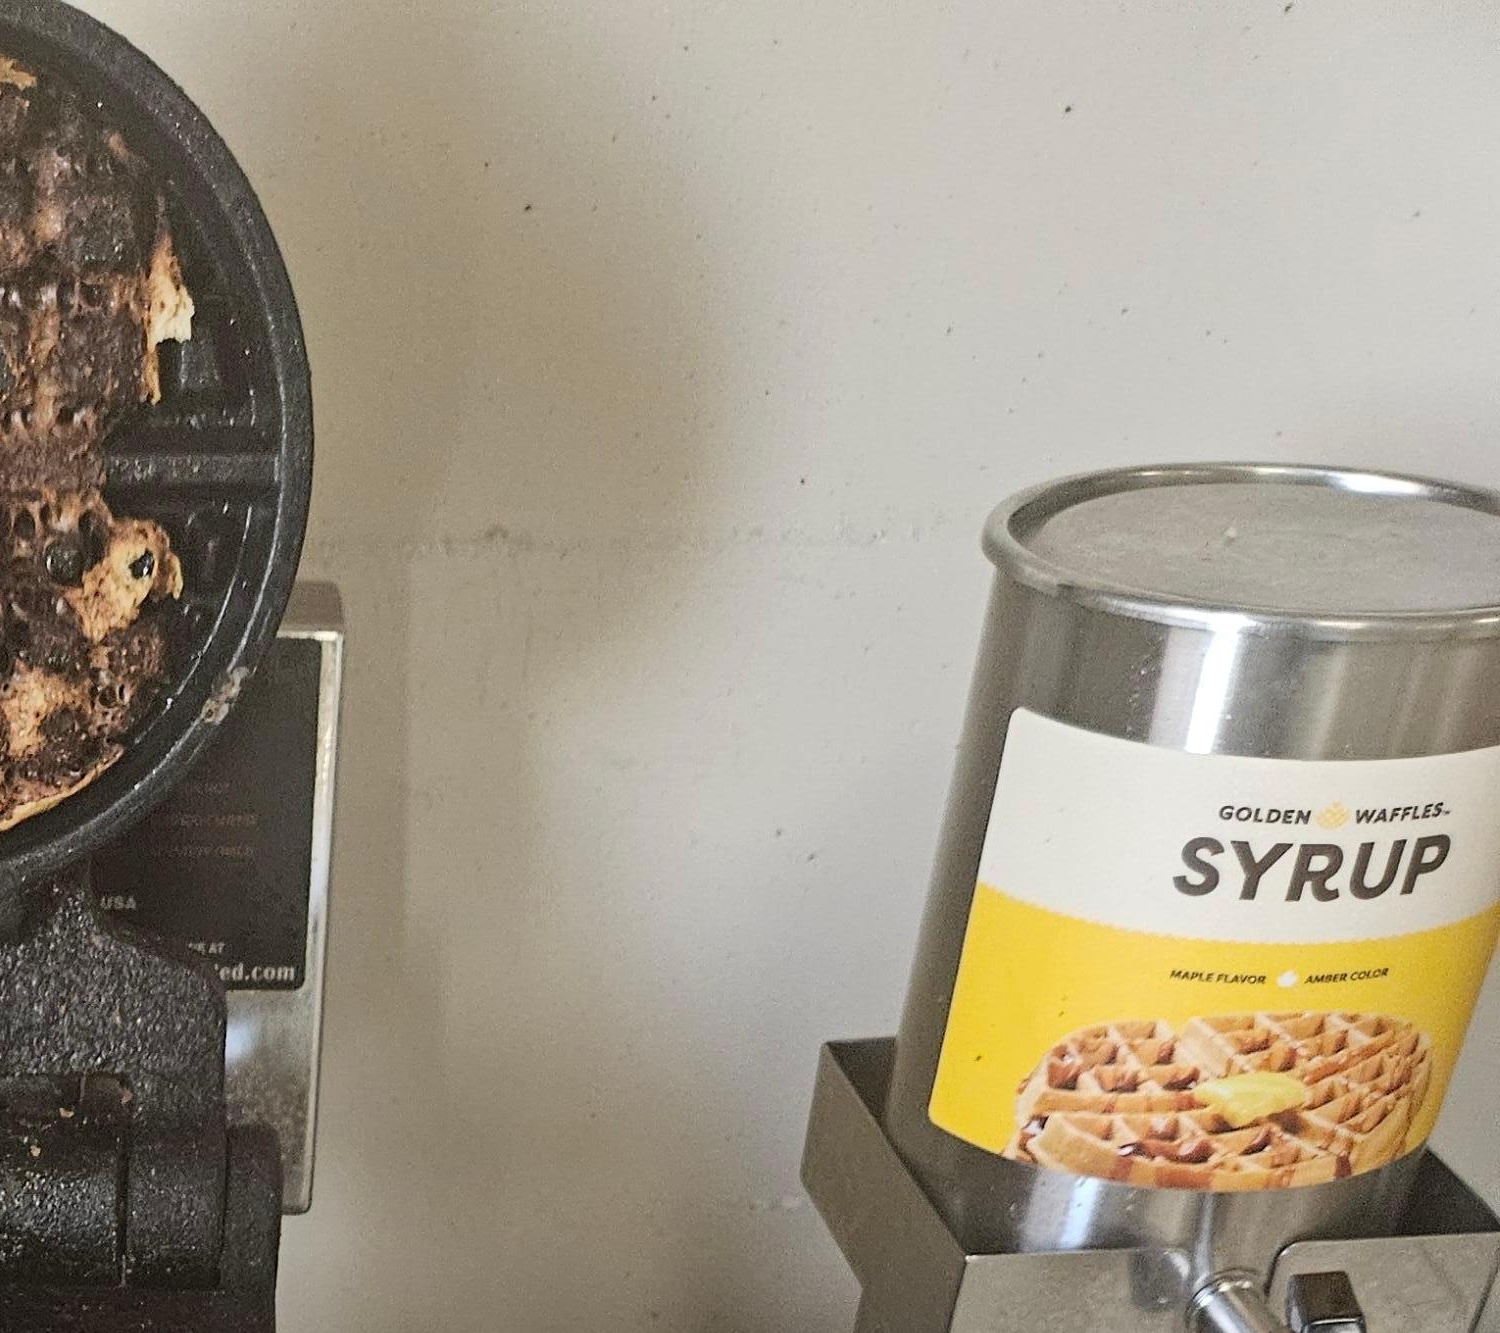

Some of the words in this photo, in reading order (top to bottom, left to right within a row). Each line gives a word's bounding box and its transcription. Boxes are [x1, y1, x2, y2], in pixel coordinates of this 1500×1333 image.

[1218, 805, 1312, 825] GOLDEN
[1172, 834, 1452, 902] SYRUP
[214, 962, 297, 982] ed.com
[1169, 969, 1214, 984] MAPLE
[1215, 972, 1268, 985] FLAVOR
[1304, 971, 1349, 985] AMBER
[1350, 967, 1390, 981] COLOR
